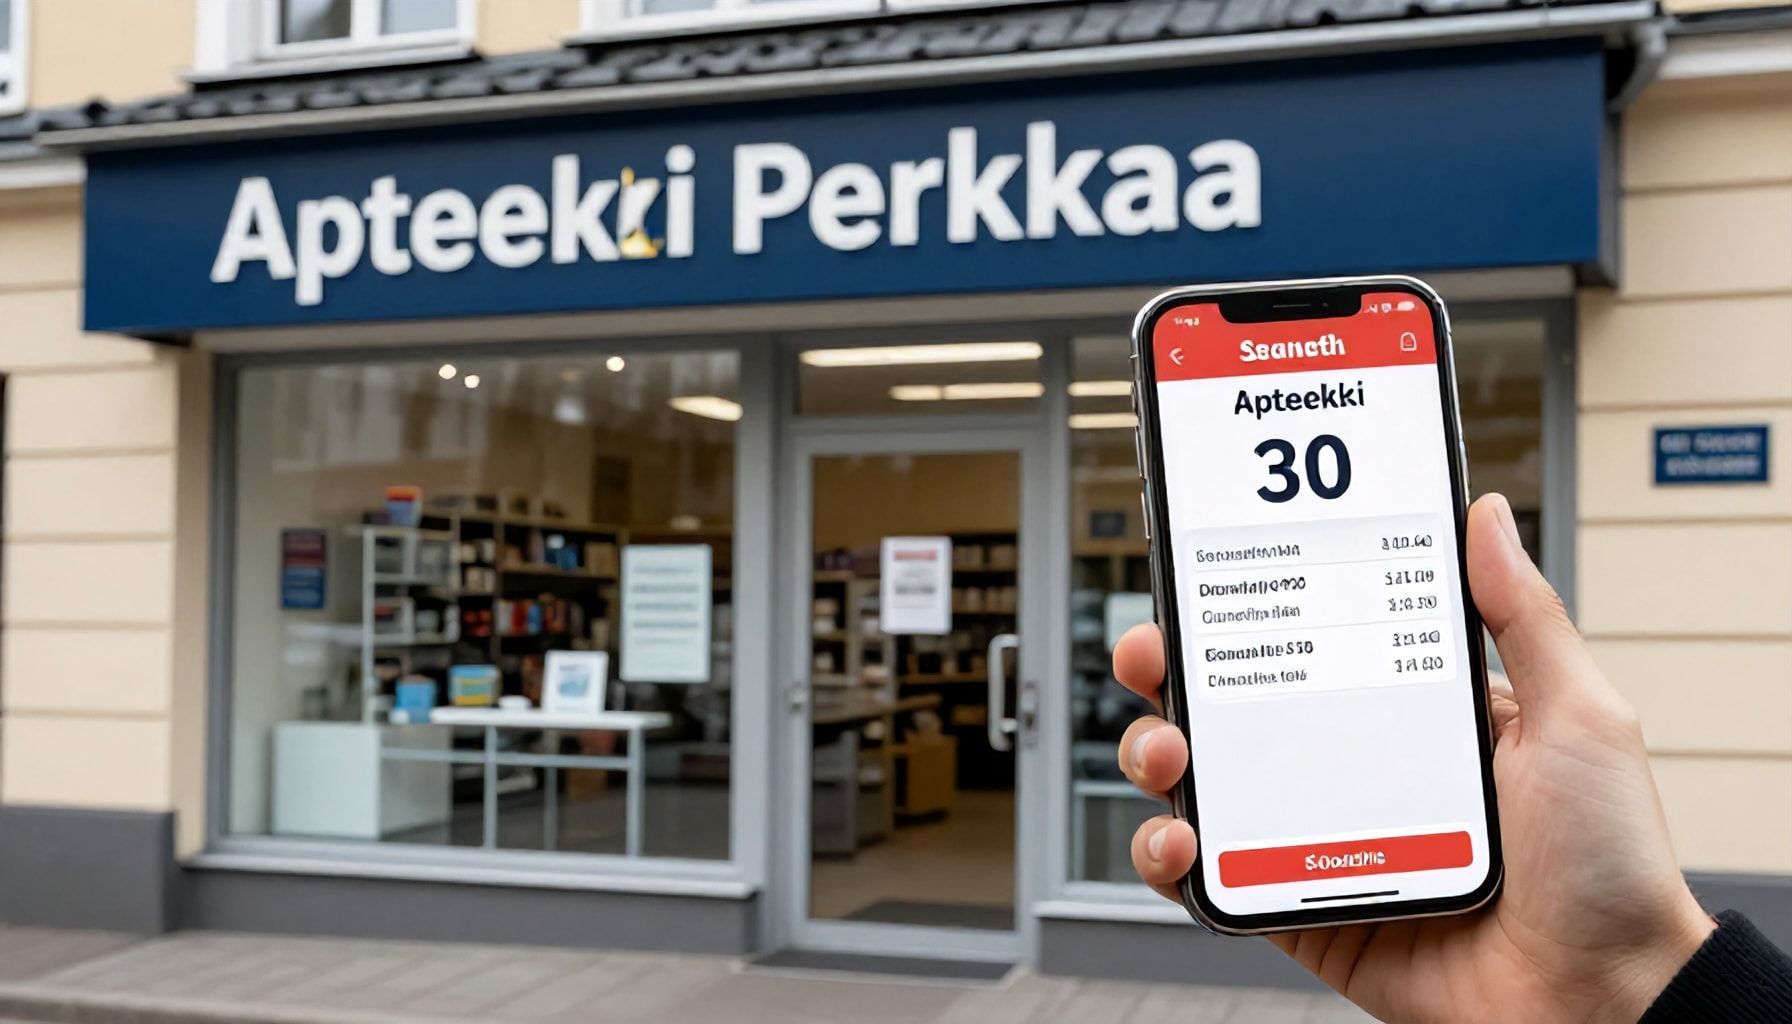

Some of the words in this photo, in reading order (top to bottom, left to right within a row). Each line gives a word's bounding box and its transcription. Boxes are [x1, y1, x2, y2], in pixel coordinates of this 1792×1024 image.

[732, 121, 1261, 254] Perkkaa
[1234, 380, 1365, 420] Apteekki
[1253, 434, 1352, 504] 30
